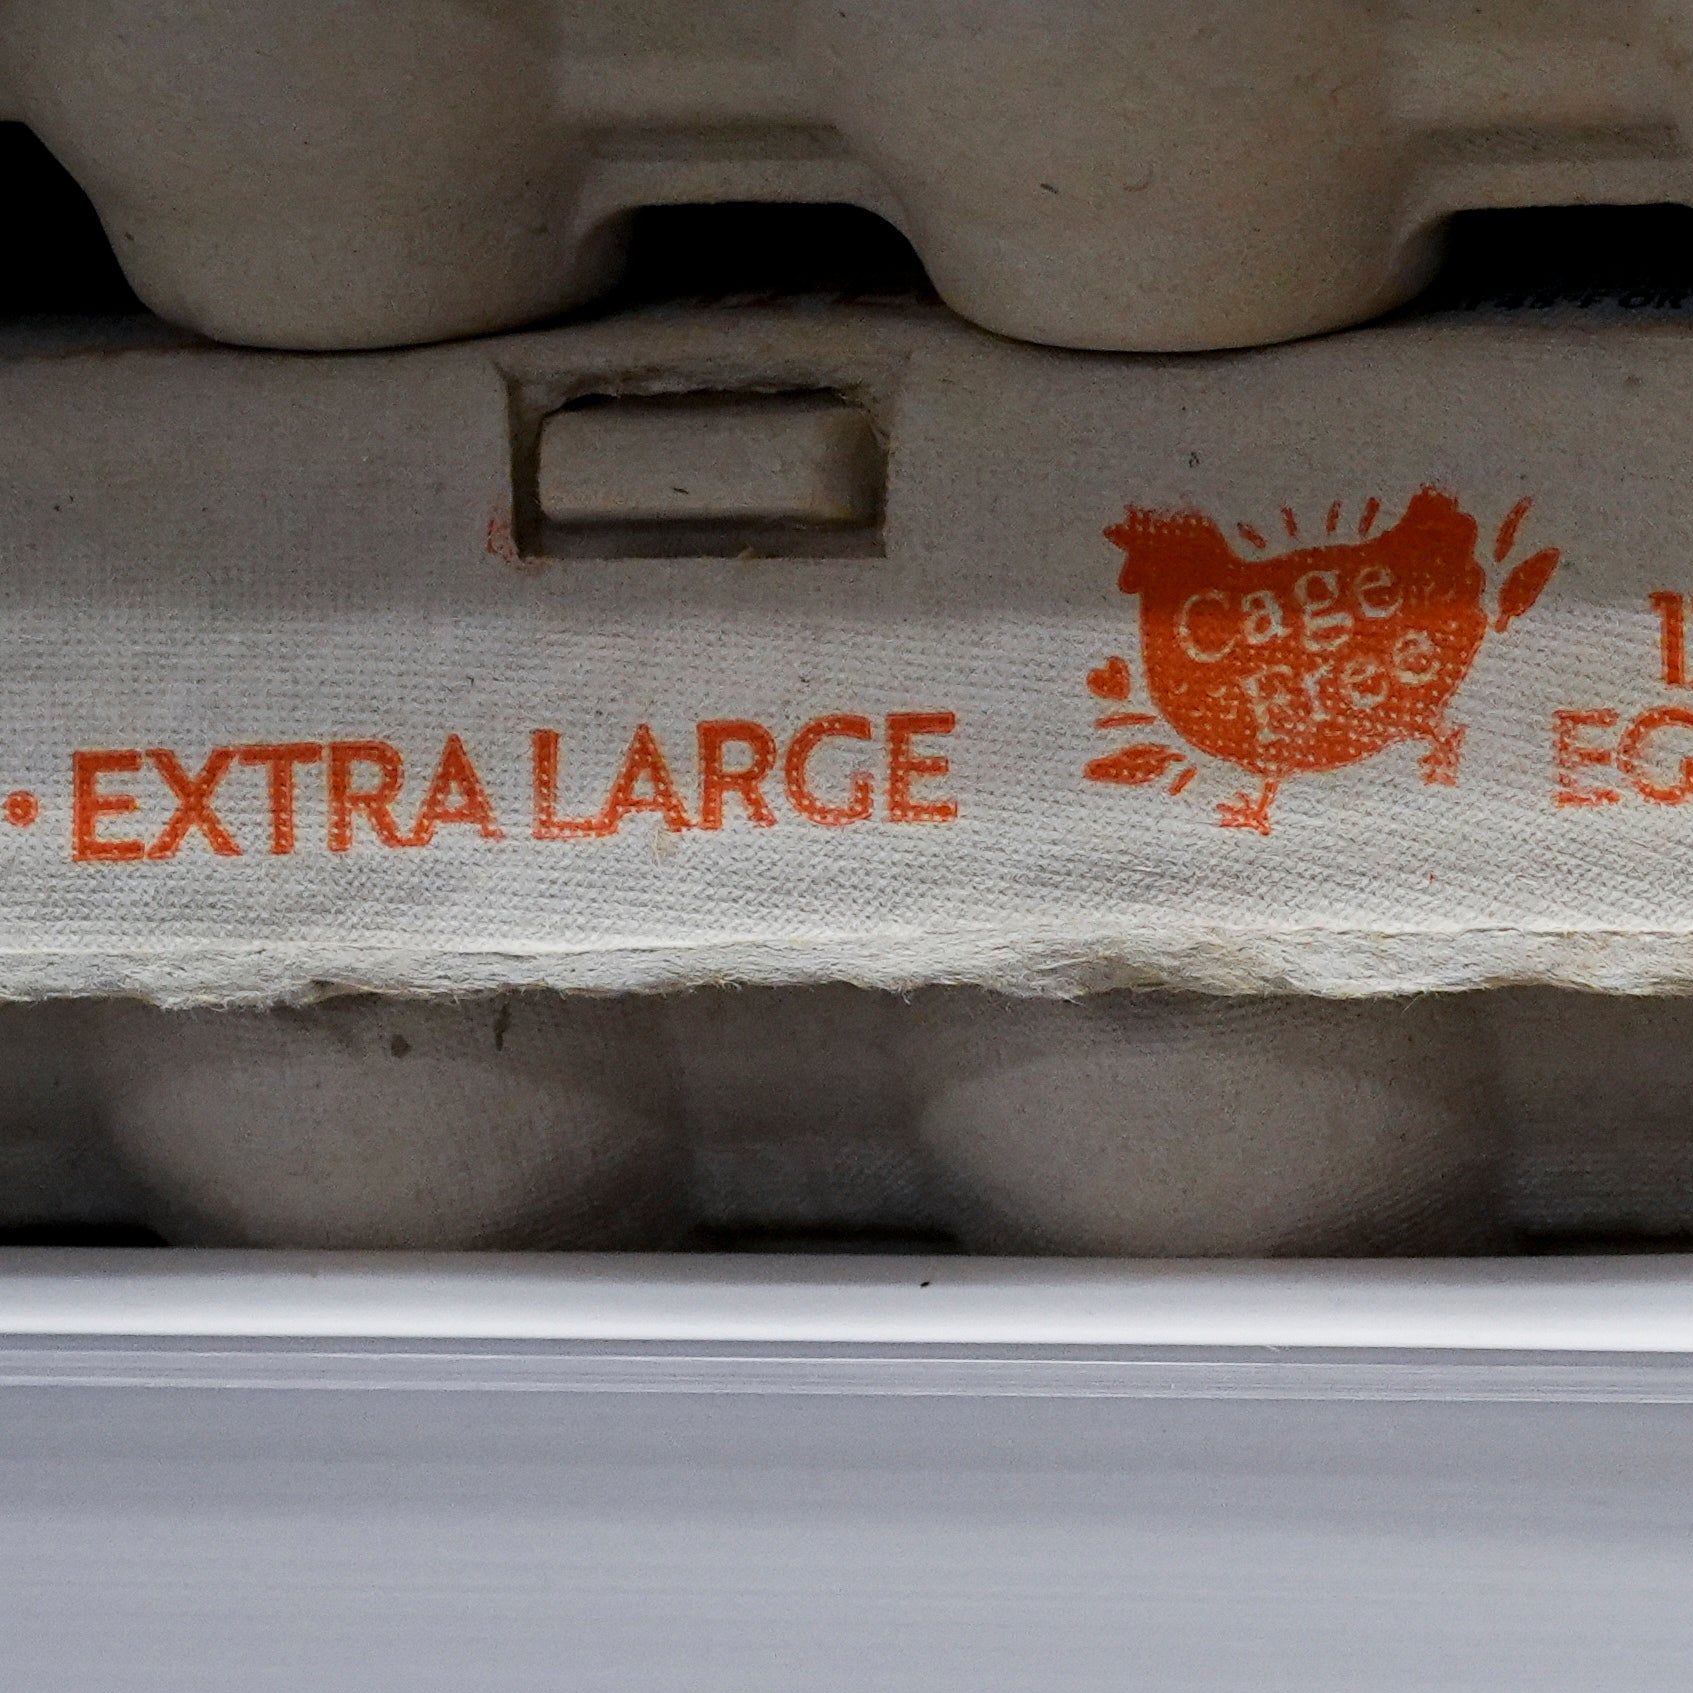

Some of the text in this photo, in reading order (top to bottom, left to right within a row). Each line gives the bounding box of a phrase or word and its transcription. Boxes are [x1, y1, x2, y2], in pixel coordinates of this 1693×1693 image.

[1175, 566, 1403, 662] Cage
[1240, 630, 1440, 742] Free
[72, 711, 958, 862] EXTRA LARGE
